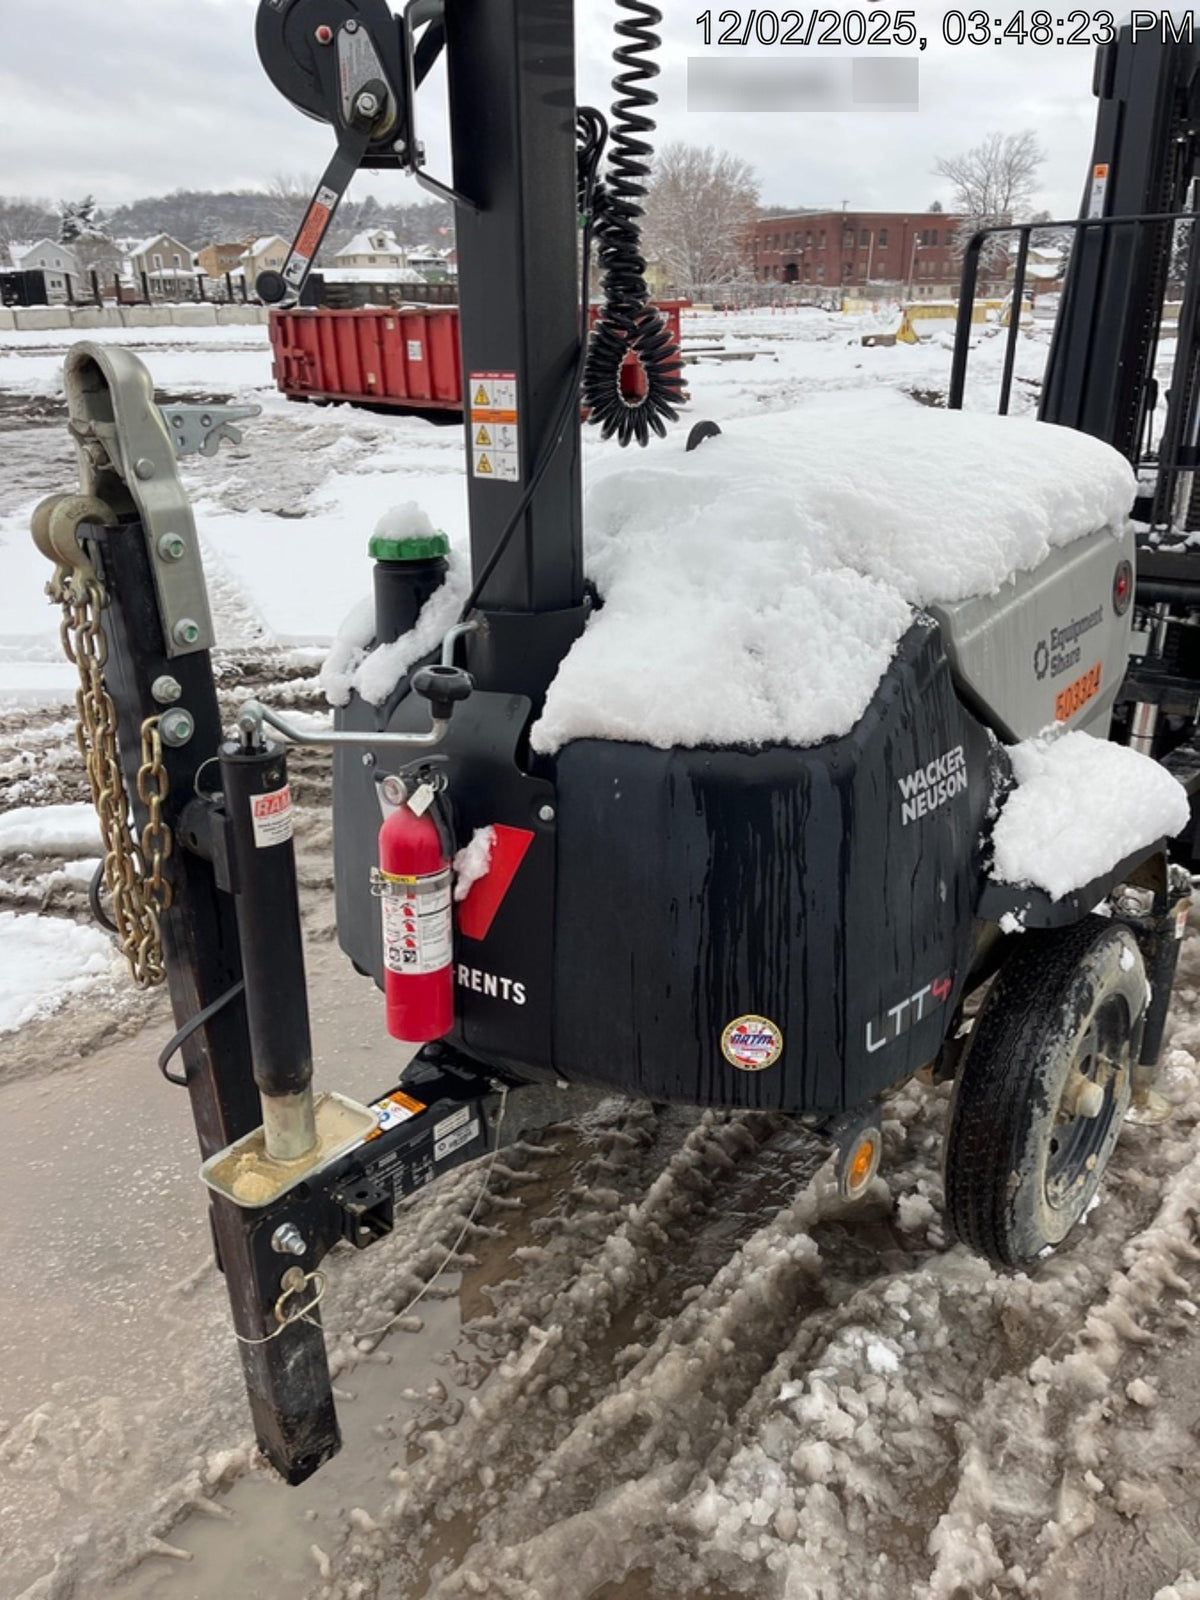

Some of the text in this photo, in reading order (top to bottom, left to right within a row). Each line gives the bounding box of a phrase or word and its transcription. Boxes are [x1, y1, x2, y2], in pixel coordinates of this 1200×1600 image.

[1050, 604, 1103, 651] Equipment
[1050, 647, 1081, 678] Share
[897, 745, 966, 799] WACKER
[901, 765, 968, 826] NEUSON
